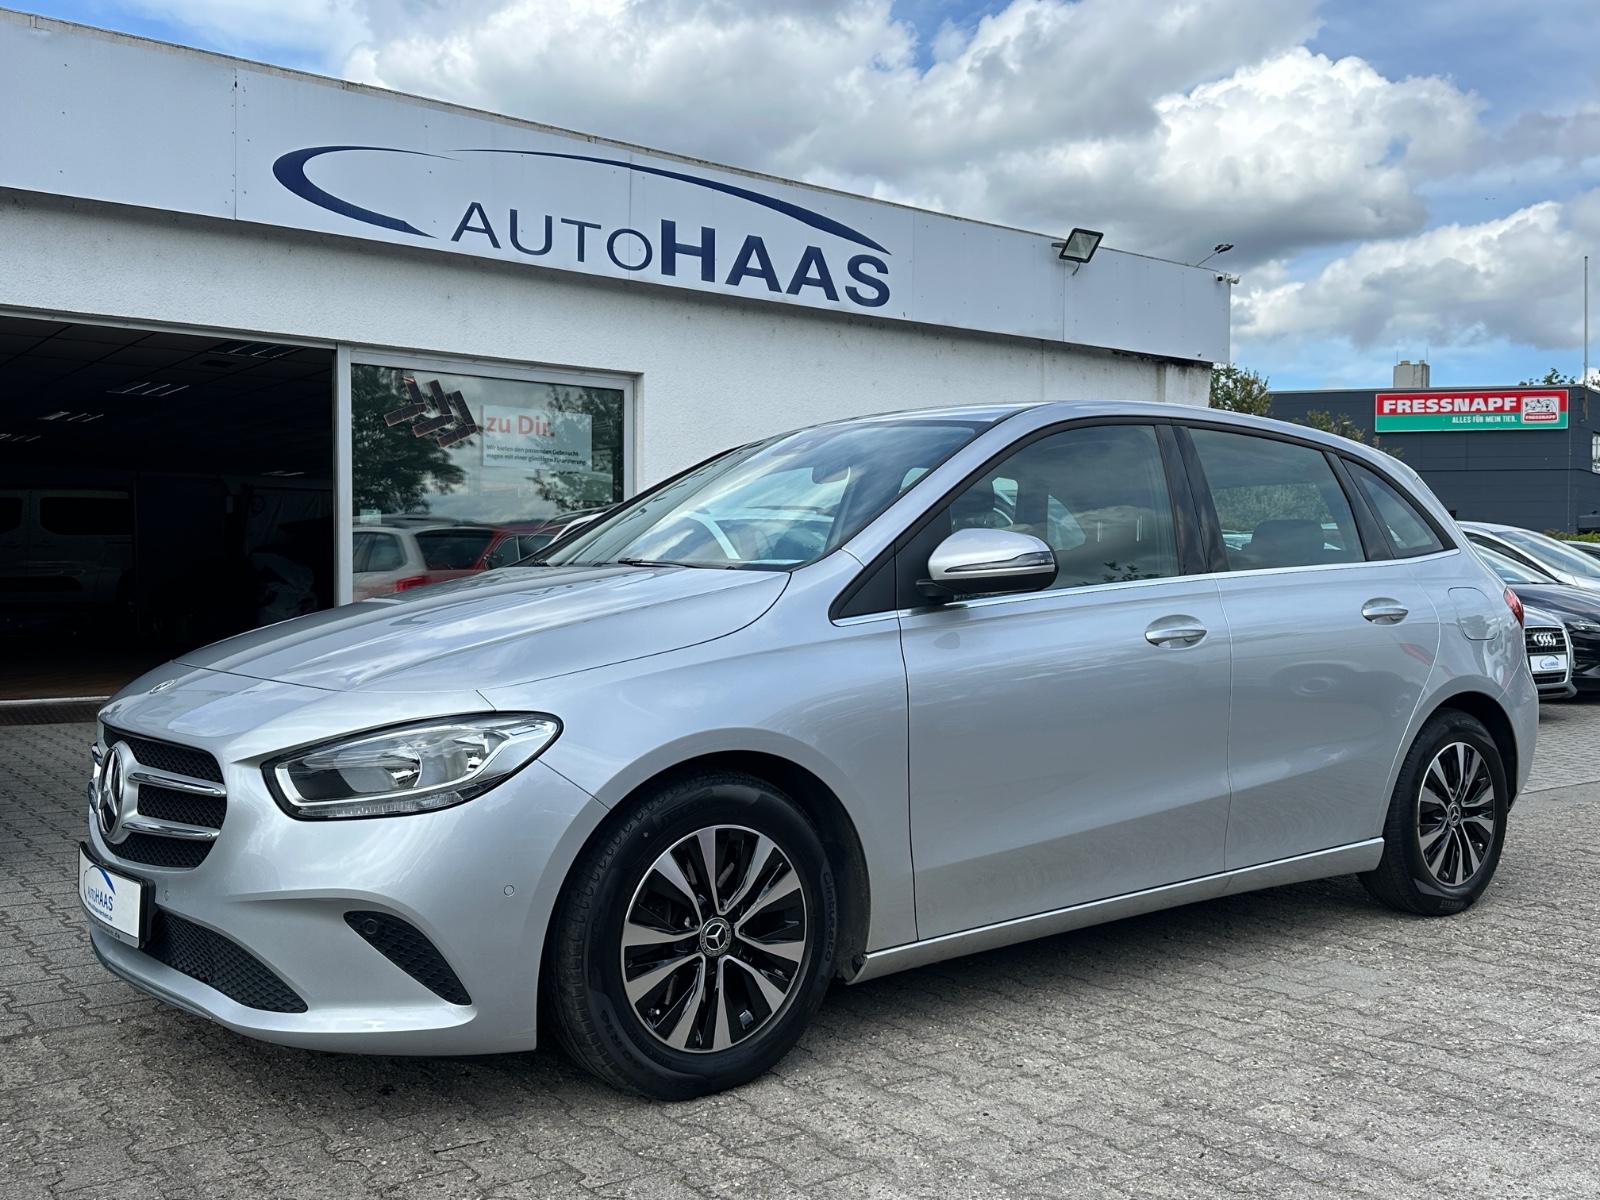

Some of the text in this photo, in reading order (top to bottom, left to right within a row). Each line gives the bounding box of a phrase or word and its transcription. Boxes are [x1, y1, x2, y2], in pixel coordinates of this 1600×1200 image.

[1383, 397, 1517, 414] FRESSNAPF
[486, 416, 511, 433] zu
[1452, 416, 1472, 424] ALLES
[1473, 415, 1484, 424] FÜR
[1485, 415, 1501, 423] MEIN
